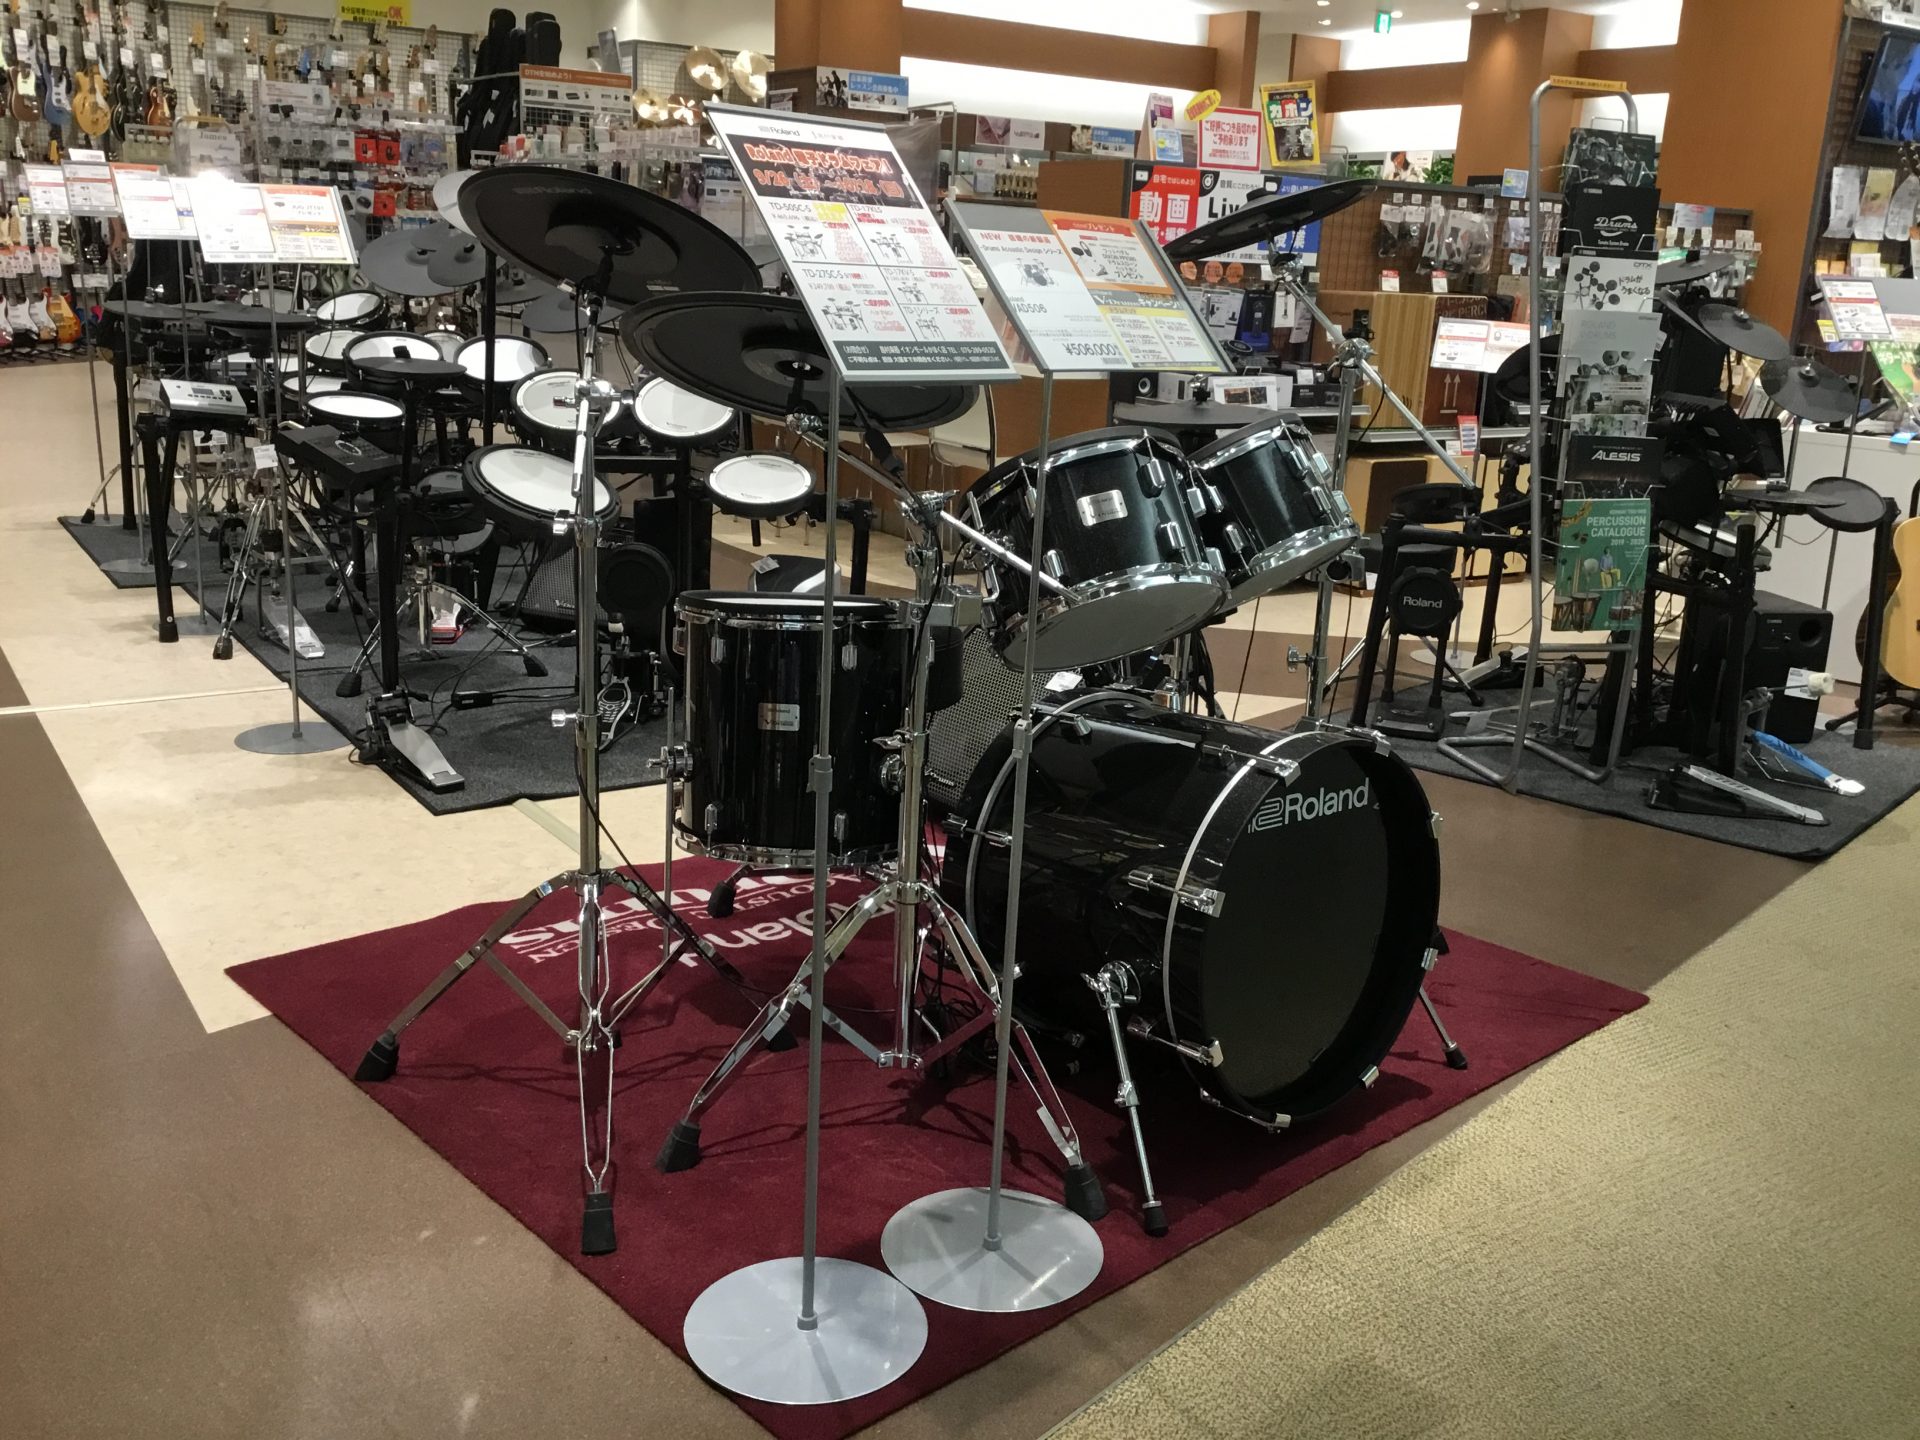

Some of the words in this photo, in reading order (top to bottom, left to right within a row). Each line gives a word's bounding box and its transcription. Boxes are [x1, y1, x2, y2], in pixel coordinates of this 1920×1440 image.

[1268, 101, 1313, 118] カホン
[1213, 134, 1248, 147] ご予約承ります
[743, 143, 797, 165] Roland
[1138, 191, 1190, 224] 動画
[1208, 196, 1241, 218] Liv
[978, 231, 1003, 241] NEW
[1619, 275, 1643, 285] ドラムが
[1621, 285, 1651, 296] うまくなる
[1062, 343, 1118, 357] ¥506,000
[1591, 449, 1641, 462] ALESIS
[1586, 515, 1647, 528] PERCUSSION
[1591, 526, 1646, 538] CATALOGUE
[1403, 596, 1443, 609] Roland
[1284, 778, 1369, 825] Roland
